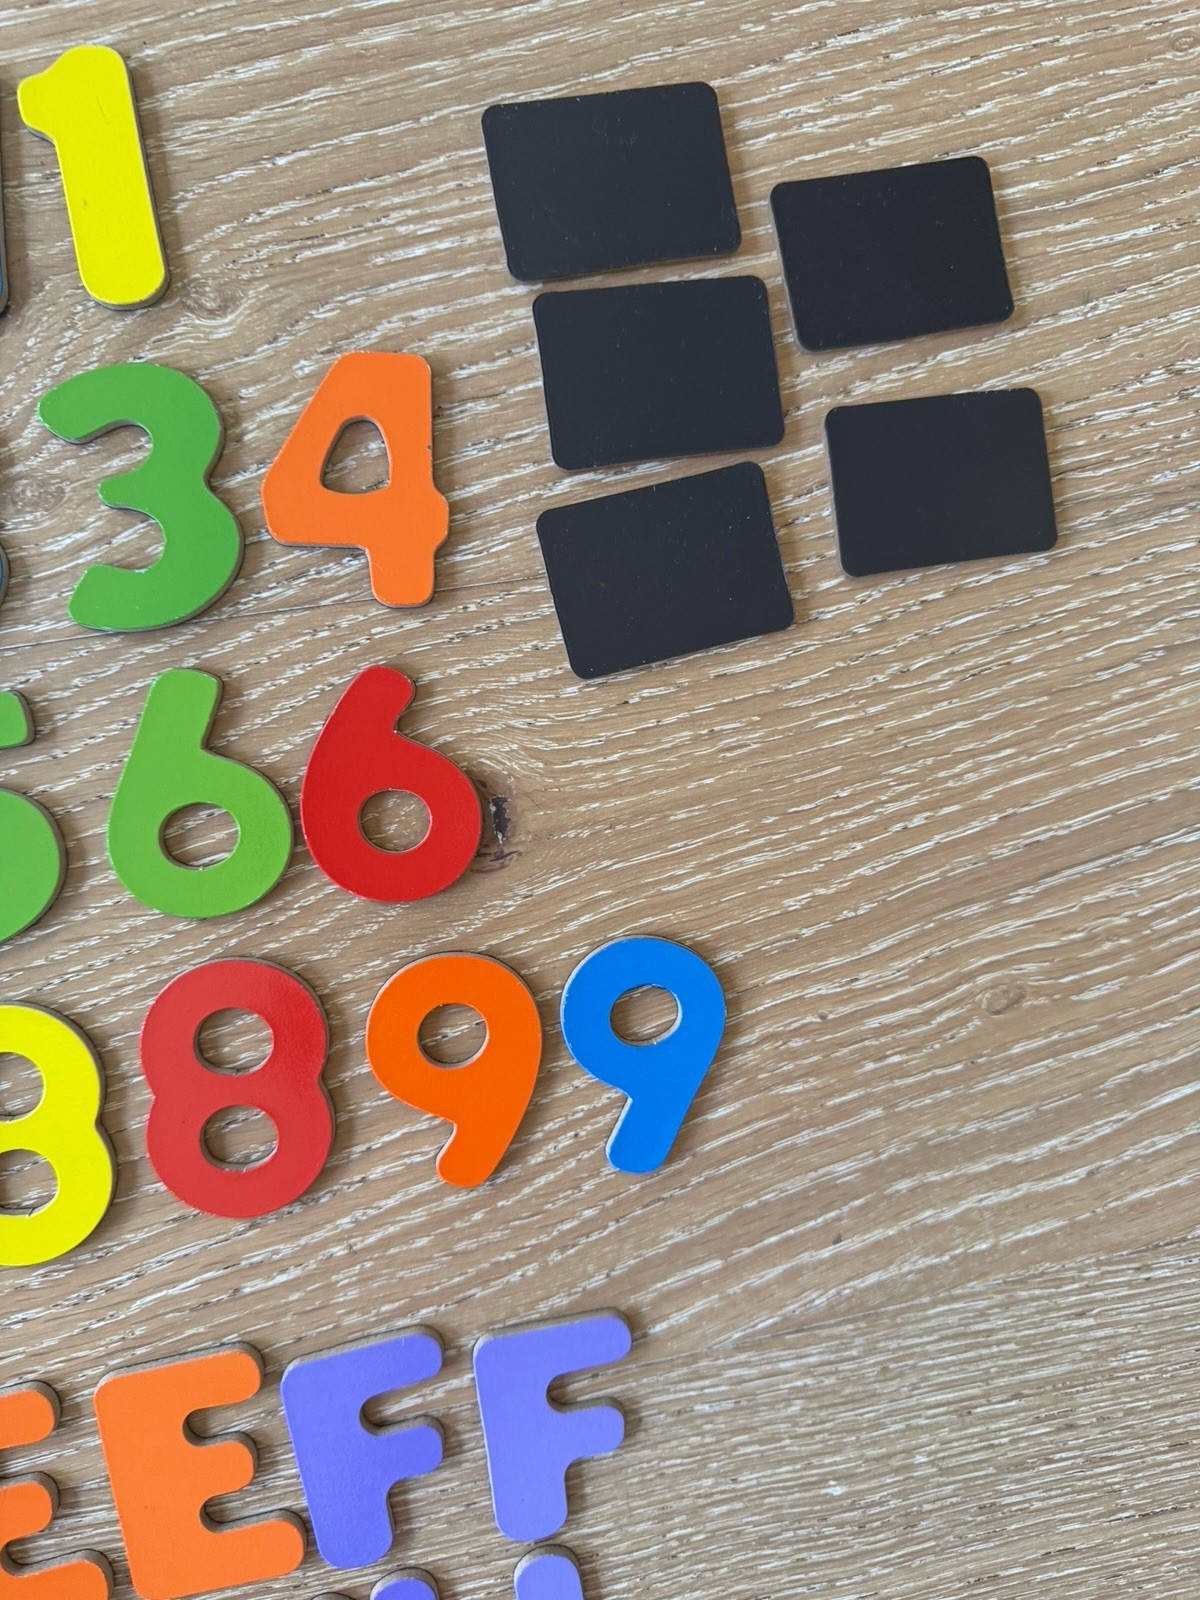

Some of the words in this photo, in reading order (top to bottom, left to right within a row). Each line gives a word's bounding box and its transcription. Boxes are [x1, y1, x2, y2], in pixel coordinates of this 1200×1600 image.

[18, 45, 167, 307] 1
[37, 362, 243, 633] 3
[261, 351, 449, 608] 4
[107, 668, 292, 919] 6
[300, 665, 483, 904] 6
[139, 959, 335, 1219] 8
[365, 952, 543, 1189] 9
[561, 936, 727, 1174] 9
[93, 1346, 308, 1600] E
[280, 1329, 445, 1569] F
[472, 1311, 632, 1542] F
